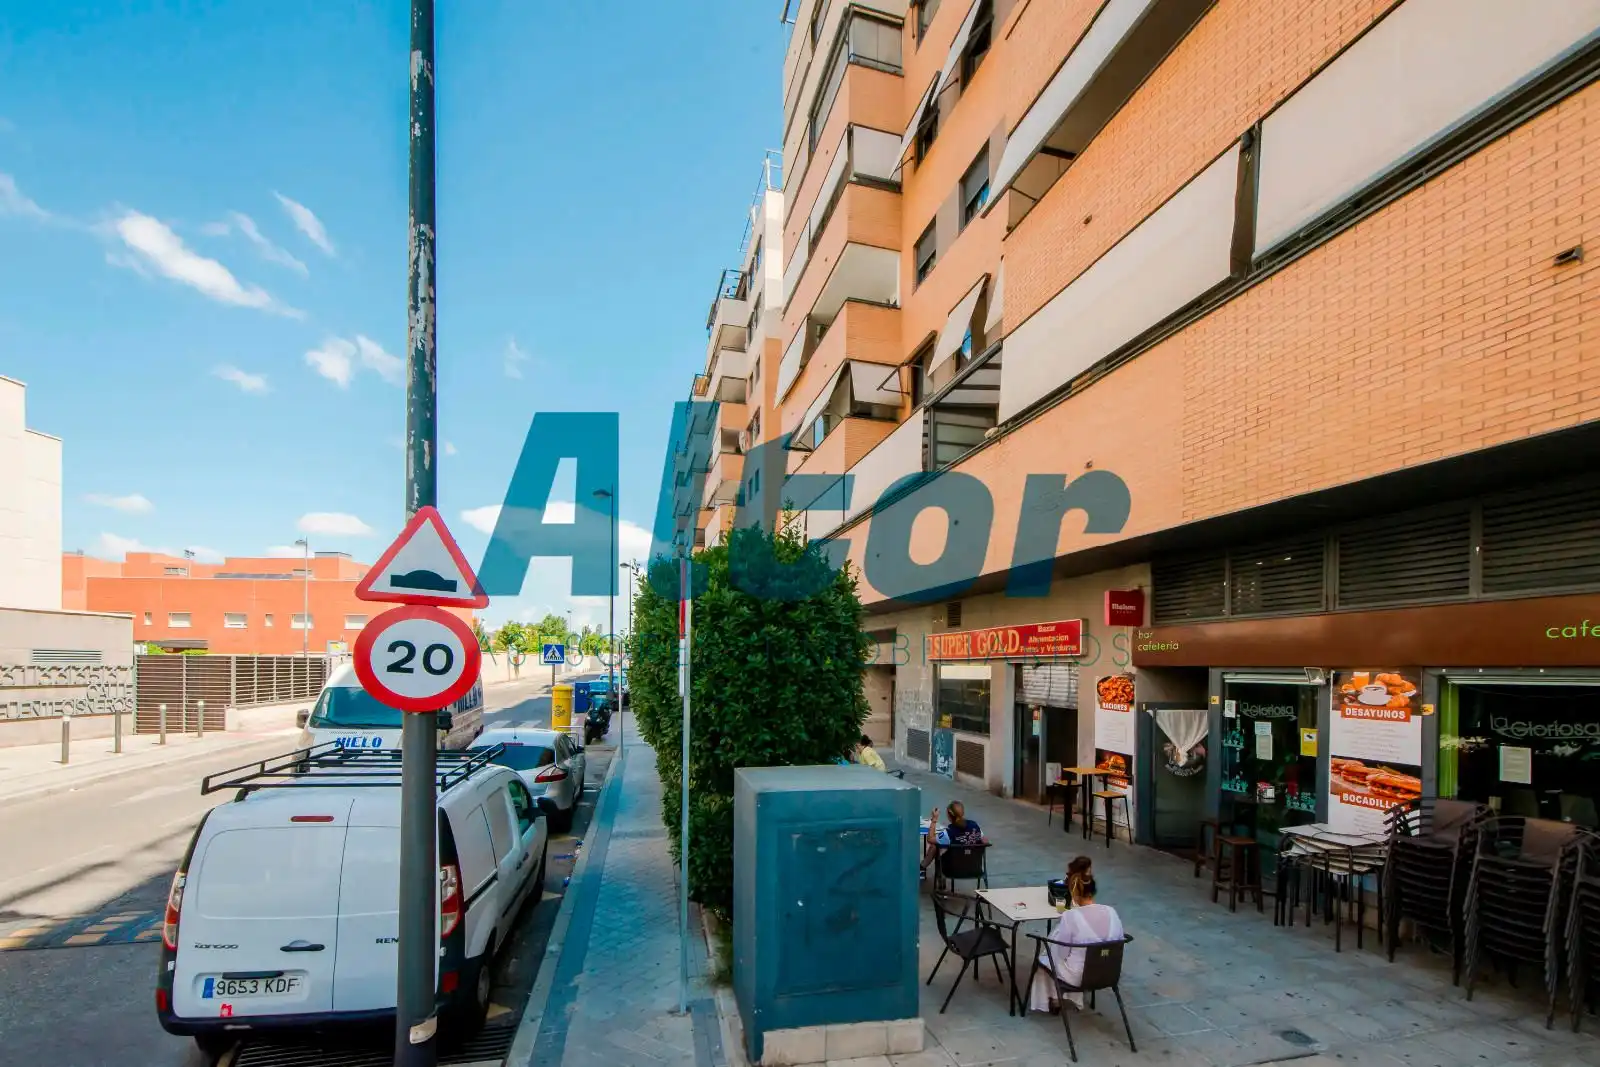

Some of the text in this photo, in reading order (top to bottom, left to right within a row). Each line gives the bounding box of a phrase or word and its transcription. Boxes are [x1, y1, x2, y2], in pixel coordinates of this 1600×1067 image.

[934, 629, 1020, 656] SUPER GOLD
[1138, 630, 1153, 639] bar
[386, 640, 453, 676] 20
[1345, 707, 1406, 719] DESAYUNOS
[1342, 793, 1407, 811] BOCADILLO
[216, 977, 299, 996] 9653 KDF
